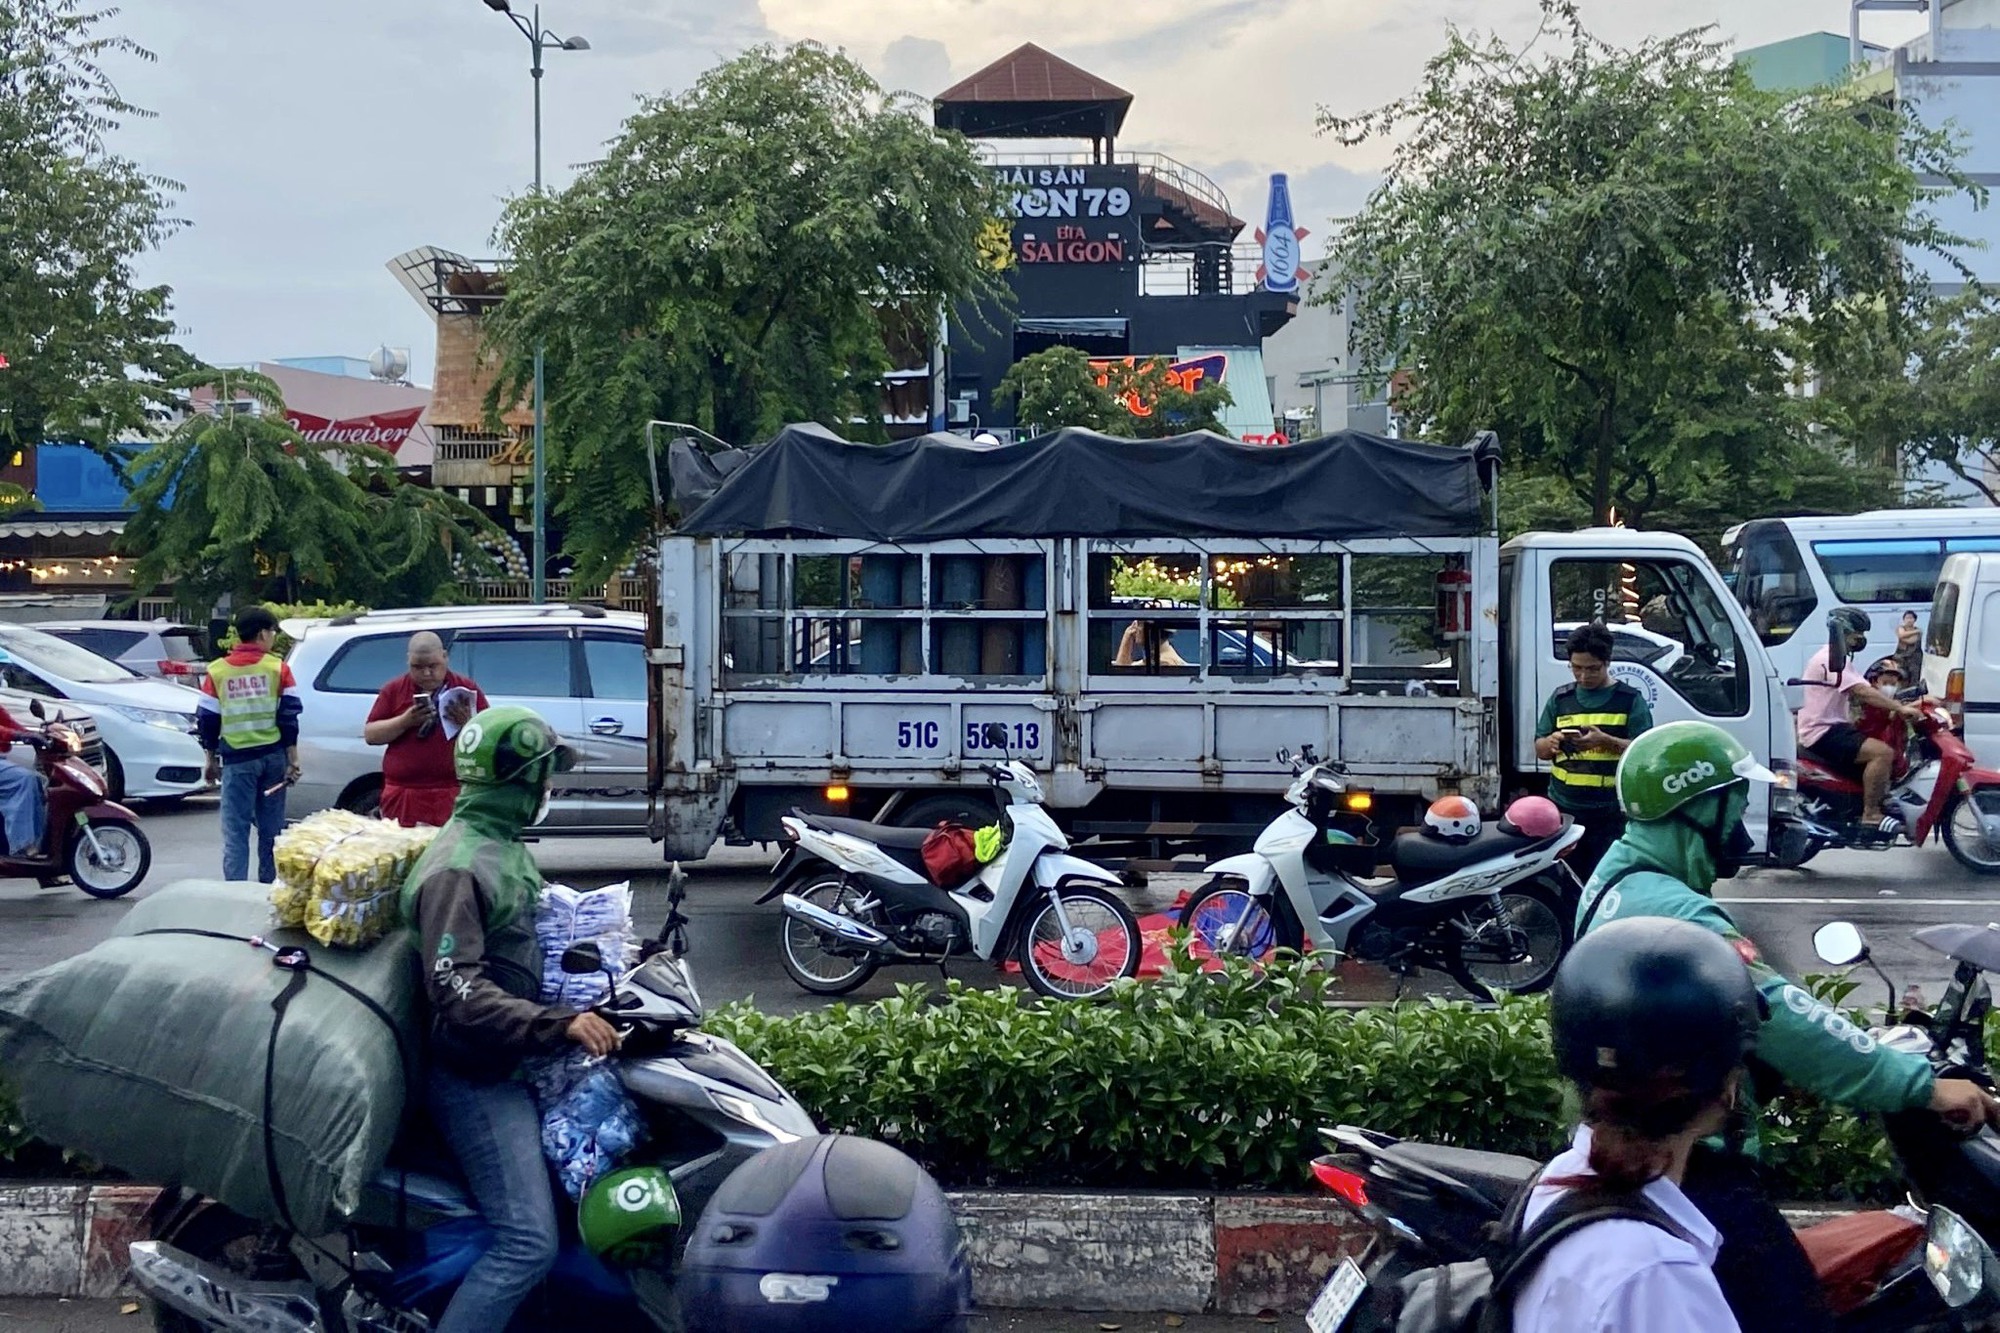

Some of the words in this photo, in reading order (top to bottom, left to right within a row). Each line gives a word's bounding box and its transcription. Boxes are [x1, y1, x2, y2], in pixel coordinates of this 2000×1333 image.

[1039, 166, 1086, 186] SẢN
[1057, 226, 1087, 240] BIA
[1022, 241, 1123, 263] SAIGON
[1269, 233, 1292, 277] 1664
[1087, 356, 1204, 417] Ter
[898, 721, 939, 748] 51C
[1662, 760, 1715, 794] Grab
[1783, 984, 1876, 1053] Grab
